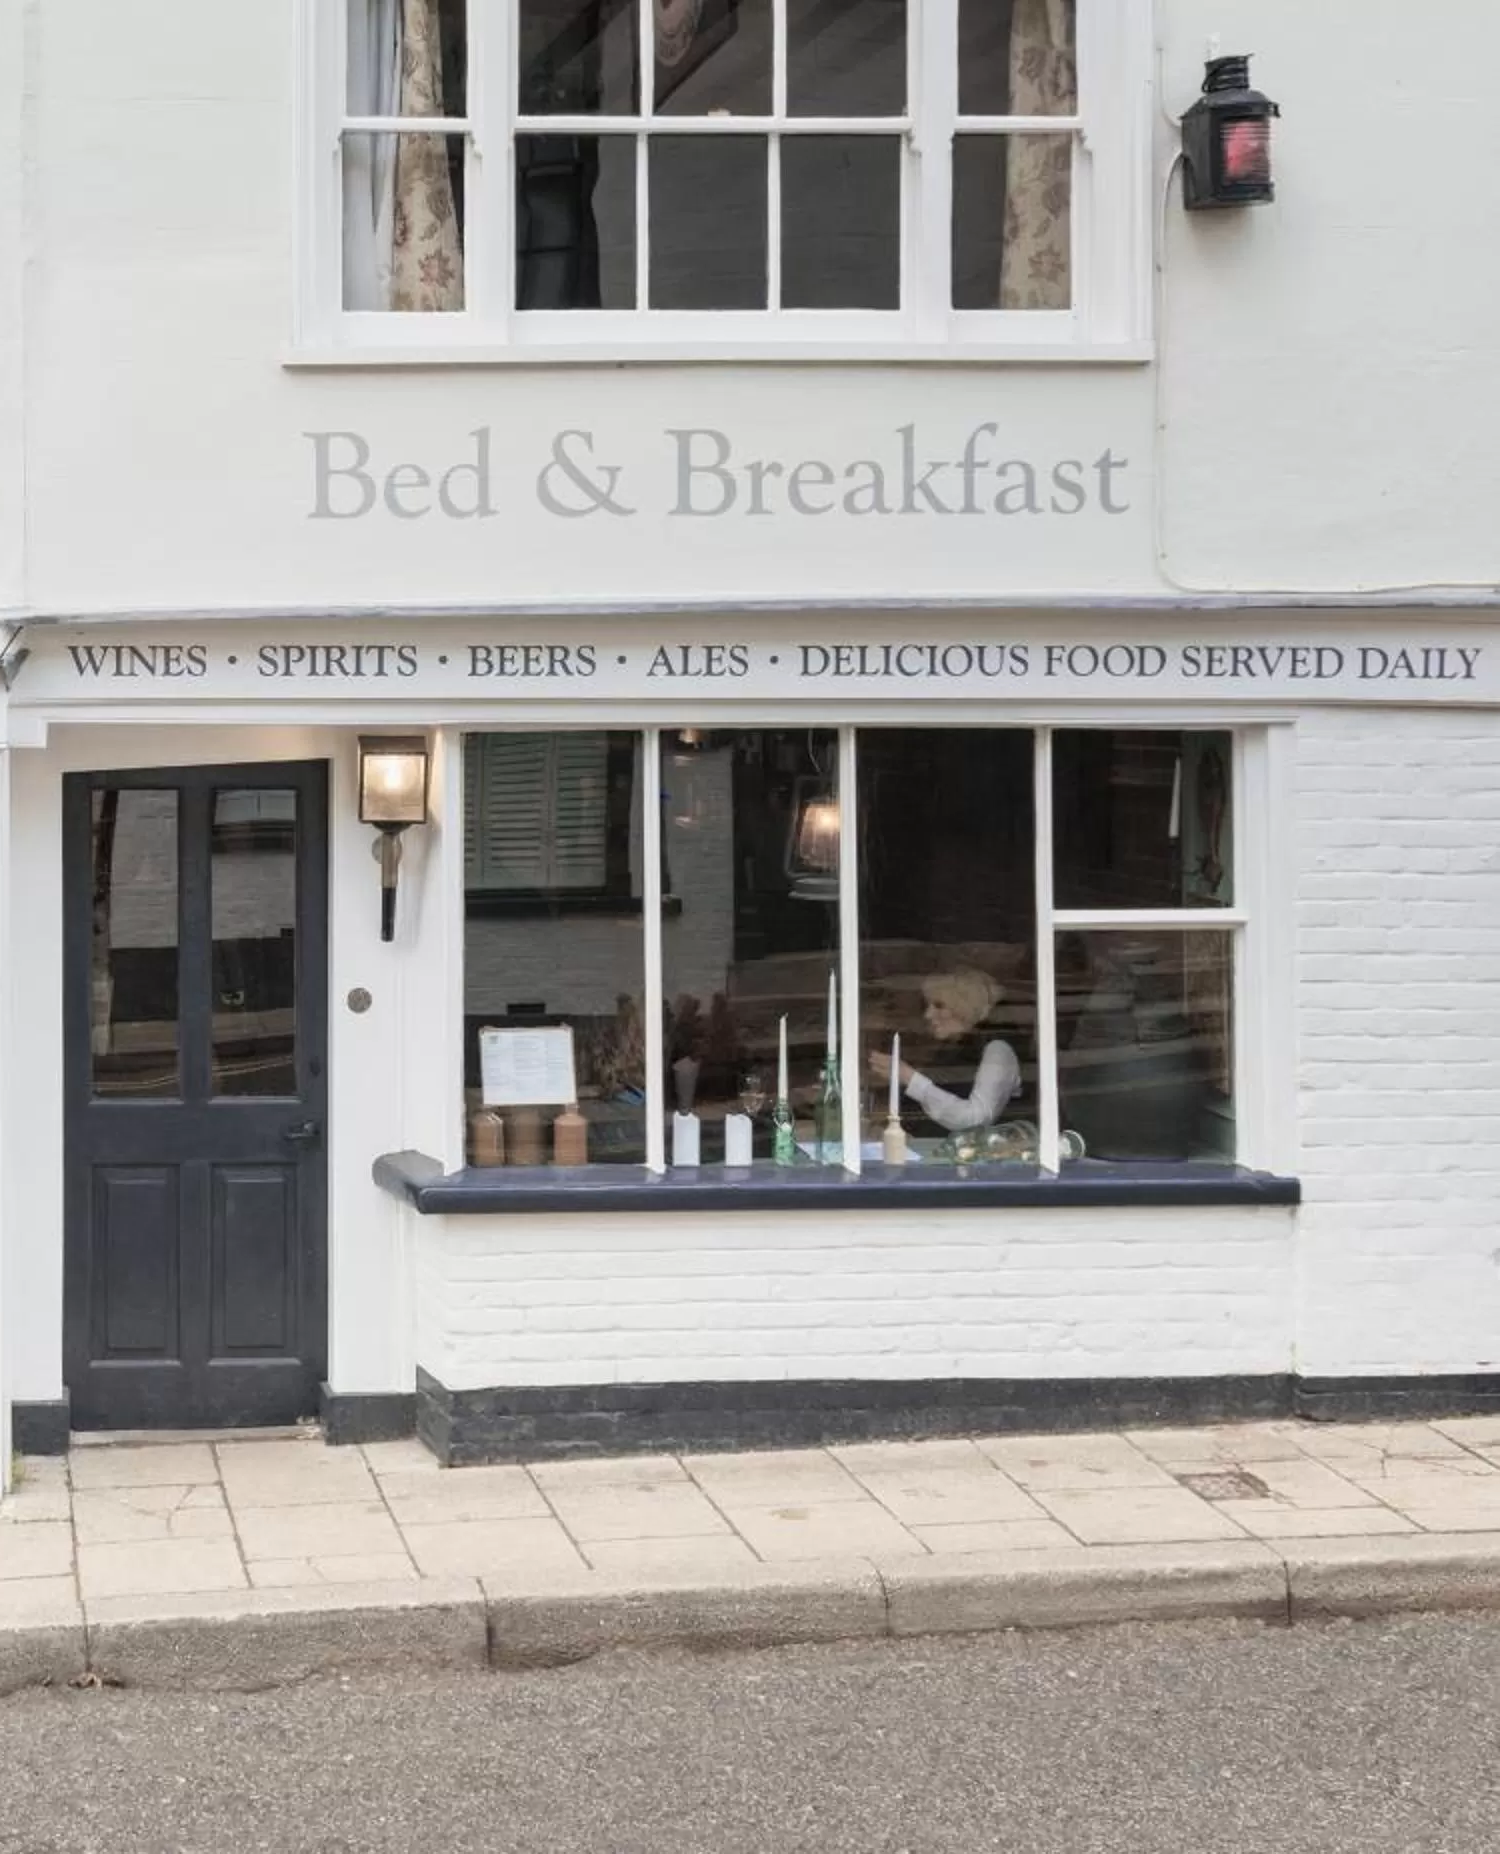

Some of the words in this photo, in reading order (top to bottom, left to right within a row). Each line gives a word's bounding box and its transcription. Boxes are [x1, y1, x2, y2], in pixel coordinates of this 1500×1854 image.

[302, 427, 498, 519] Bed
[536, 430, 638, 519] &
[664, 422, 1130, 516] Breakfast
[67, 644, 208, 678] WINES
[257, 644, 418, 678] SPIRITS
[467, 644, 597, 678] BEERS
[646, 644, 750, 678] ALES
[799, 644, 1030, 678] DELICIOUS
[1044, 645, 1167, 678] FOOD
[1181, 645, 1344, 679] SERVED
[1357, 646, 1482, 680] DAILY
